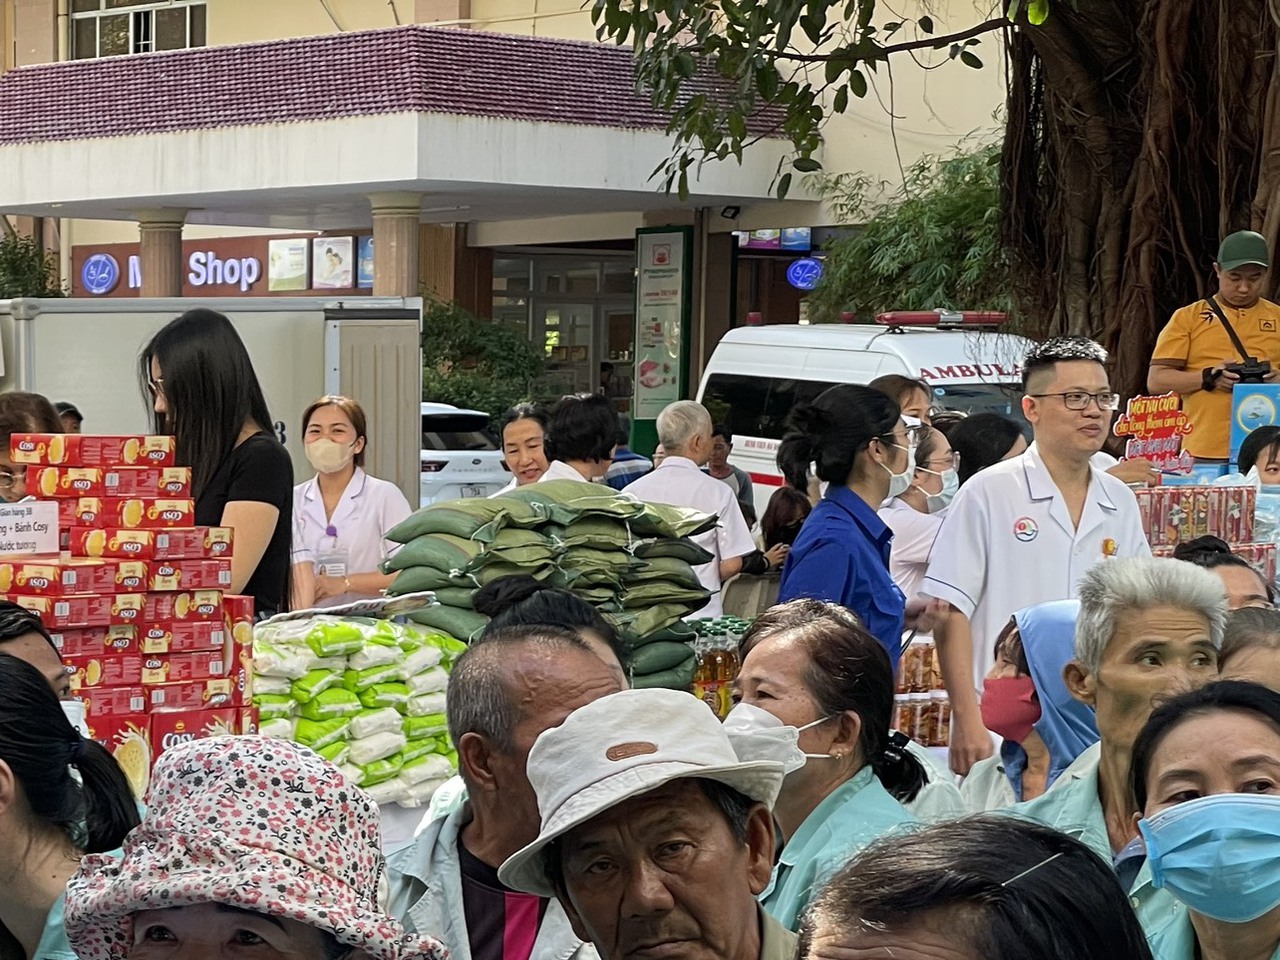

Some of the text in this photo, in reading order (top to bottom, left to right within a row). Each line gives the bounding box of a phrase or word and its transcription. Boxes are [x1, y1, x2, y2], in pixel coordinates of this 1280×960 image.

[188, 251, 261, 292] Shop
[920, 364, 1023, 380] AMBUL
[15, 522, 32, 533] Bánh
[33, 521, 49, 534] Cosy
